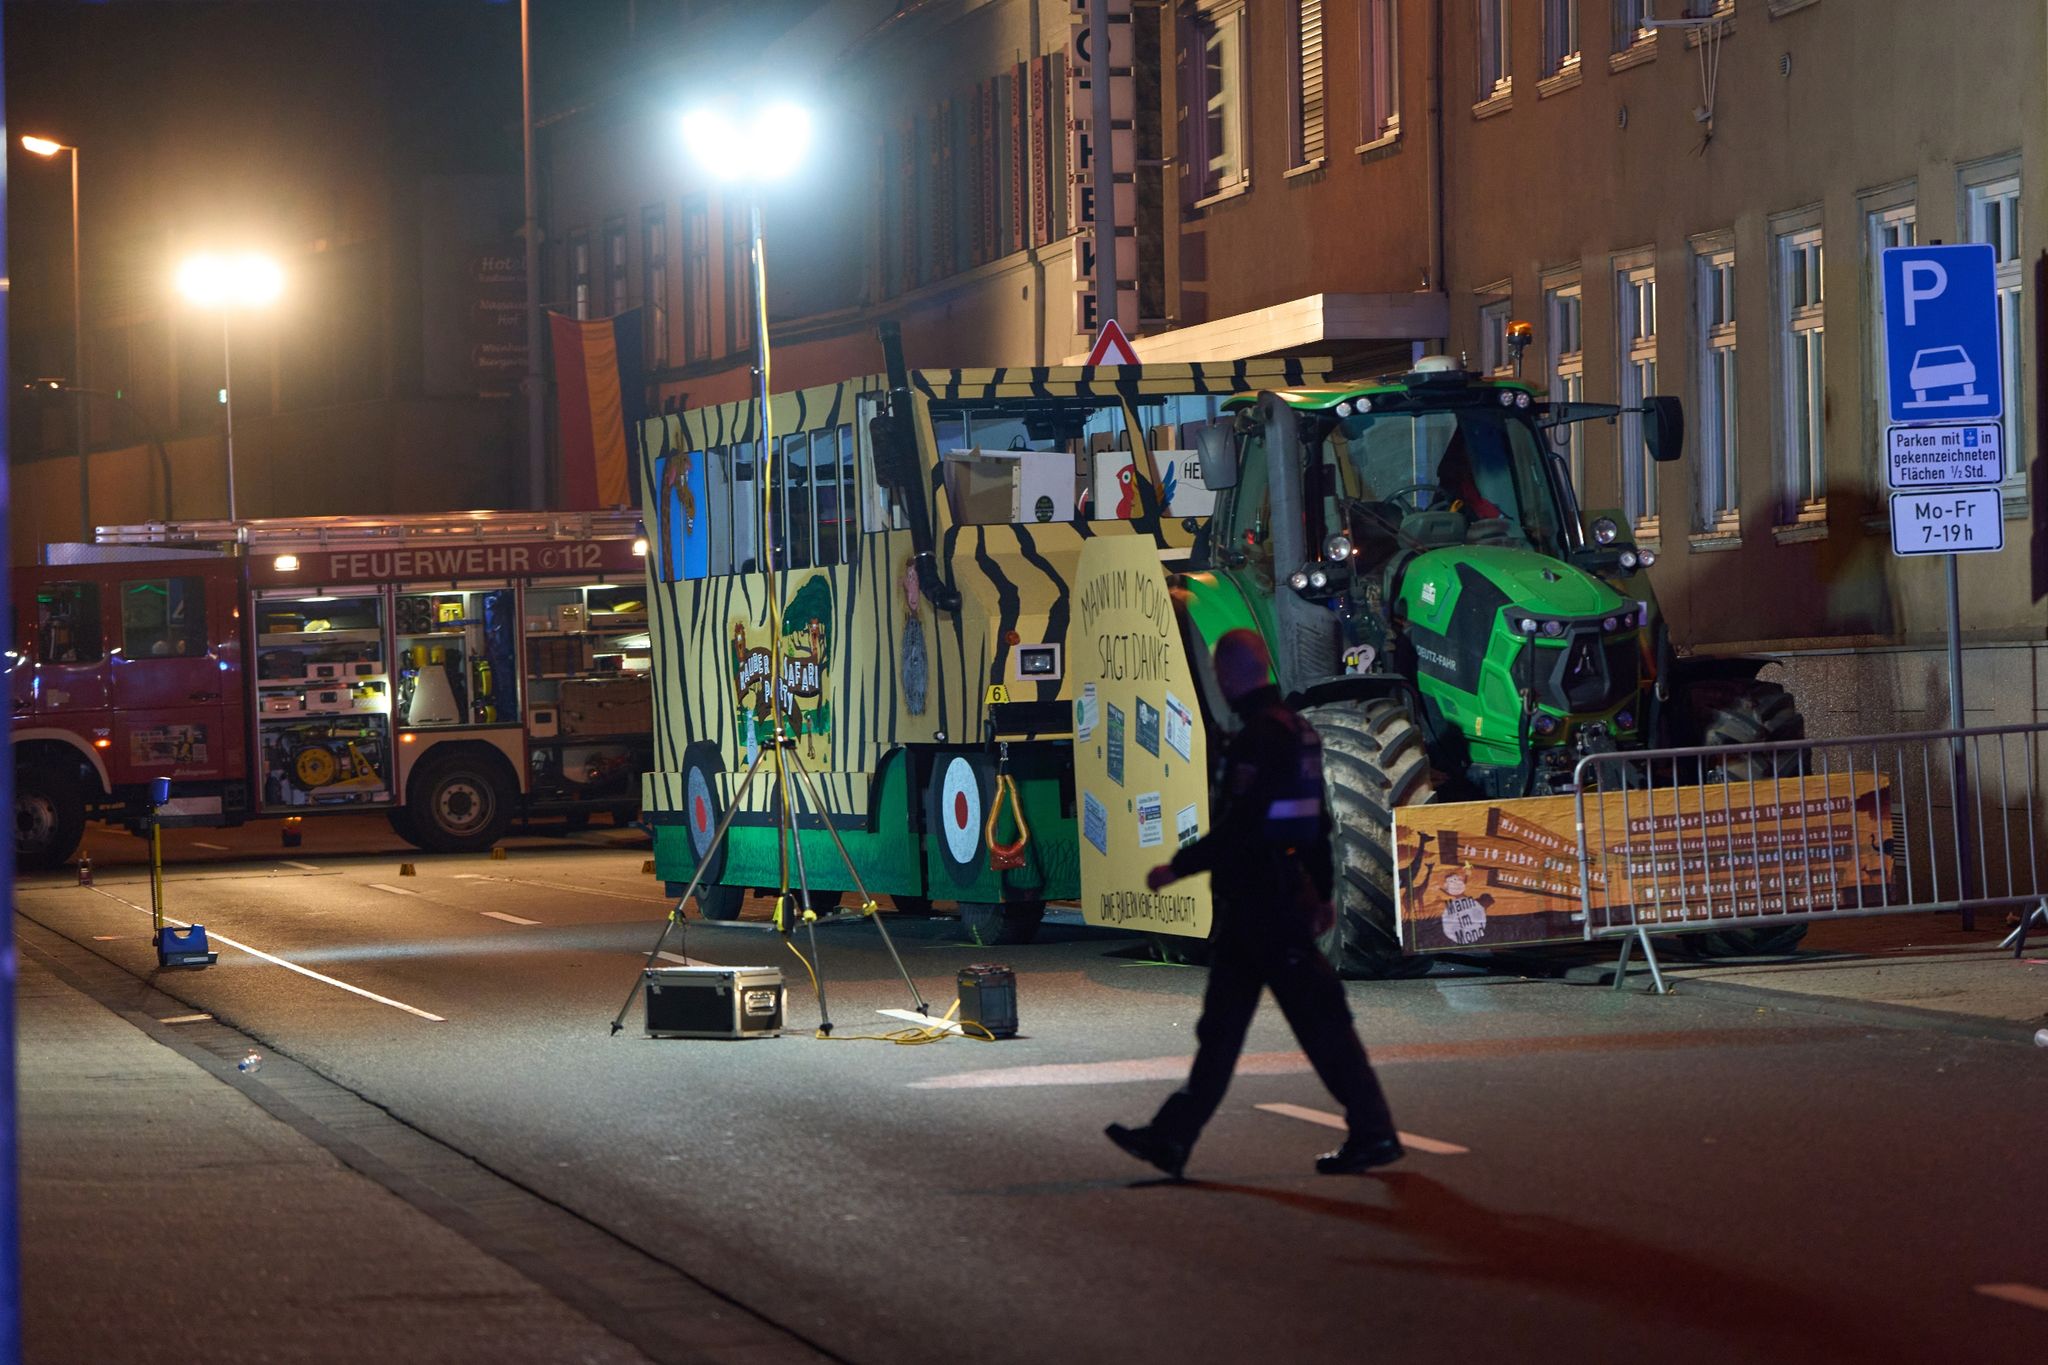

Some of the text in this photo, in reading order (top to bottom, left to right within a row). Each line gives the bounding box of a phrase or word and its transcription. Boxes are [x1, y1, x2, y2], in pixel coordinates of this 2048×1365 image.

[1902, 260, 1948, 326] P
[1896, 429, 1992, 447] Parken mit in
[1894, 448, 1996, 468] gekennzeichneten
[1901, 466, 1945, 481] Flächen
[1965, 464, 1987, 478] Std.
[1915, 500, 1976, 520] Mo-Fr
[330, 546, 530, 579] FEUERWEHR
[1135, 570, 1170, 638] MOND
[1098, 633, 1171, 682] SAGT DANKE
[993, 687, 1001, 701] 6
[1445, 896, 1476, 915] Mann
[1456, 913, 1473, 929] im
[1454, 921, 1486, 946] Mond
